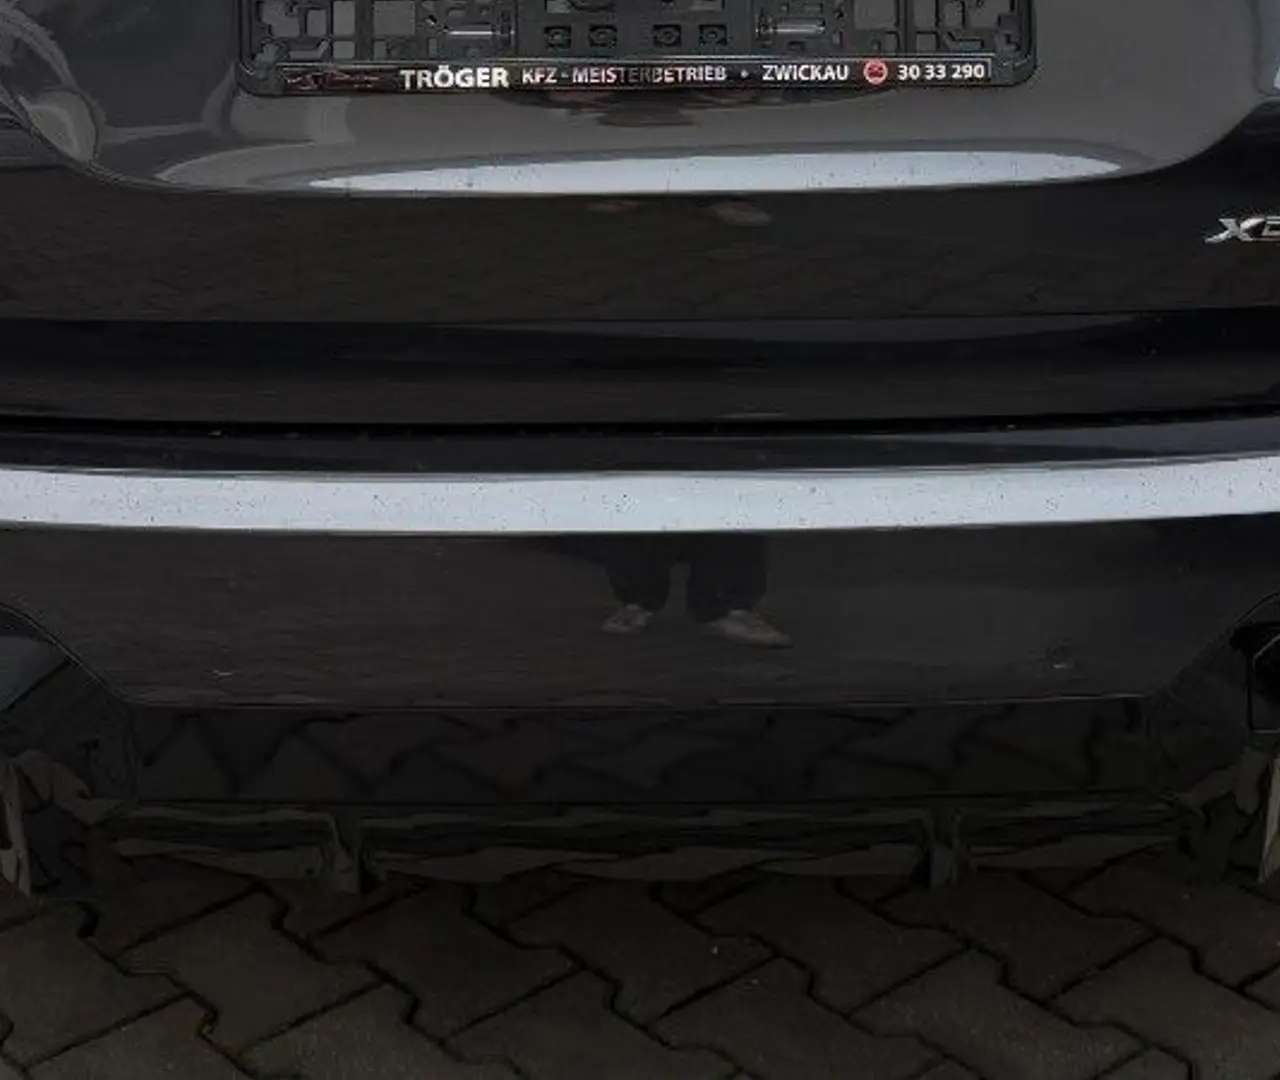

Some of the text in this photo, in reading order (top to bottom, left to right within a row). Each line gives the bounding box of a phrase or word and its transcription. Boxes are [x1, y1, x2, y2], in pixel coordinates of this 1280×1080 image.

[399, 65, 510, 90] TRÖGER
[761, 63, 849, 81] ZWICKAU
[897, 64, 920, 80] 30
[924, 64, 946, 80] 33
[951, 63, 985, 79] 290
